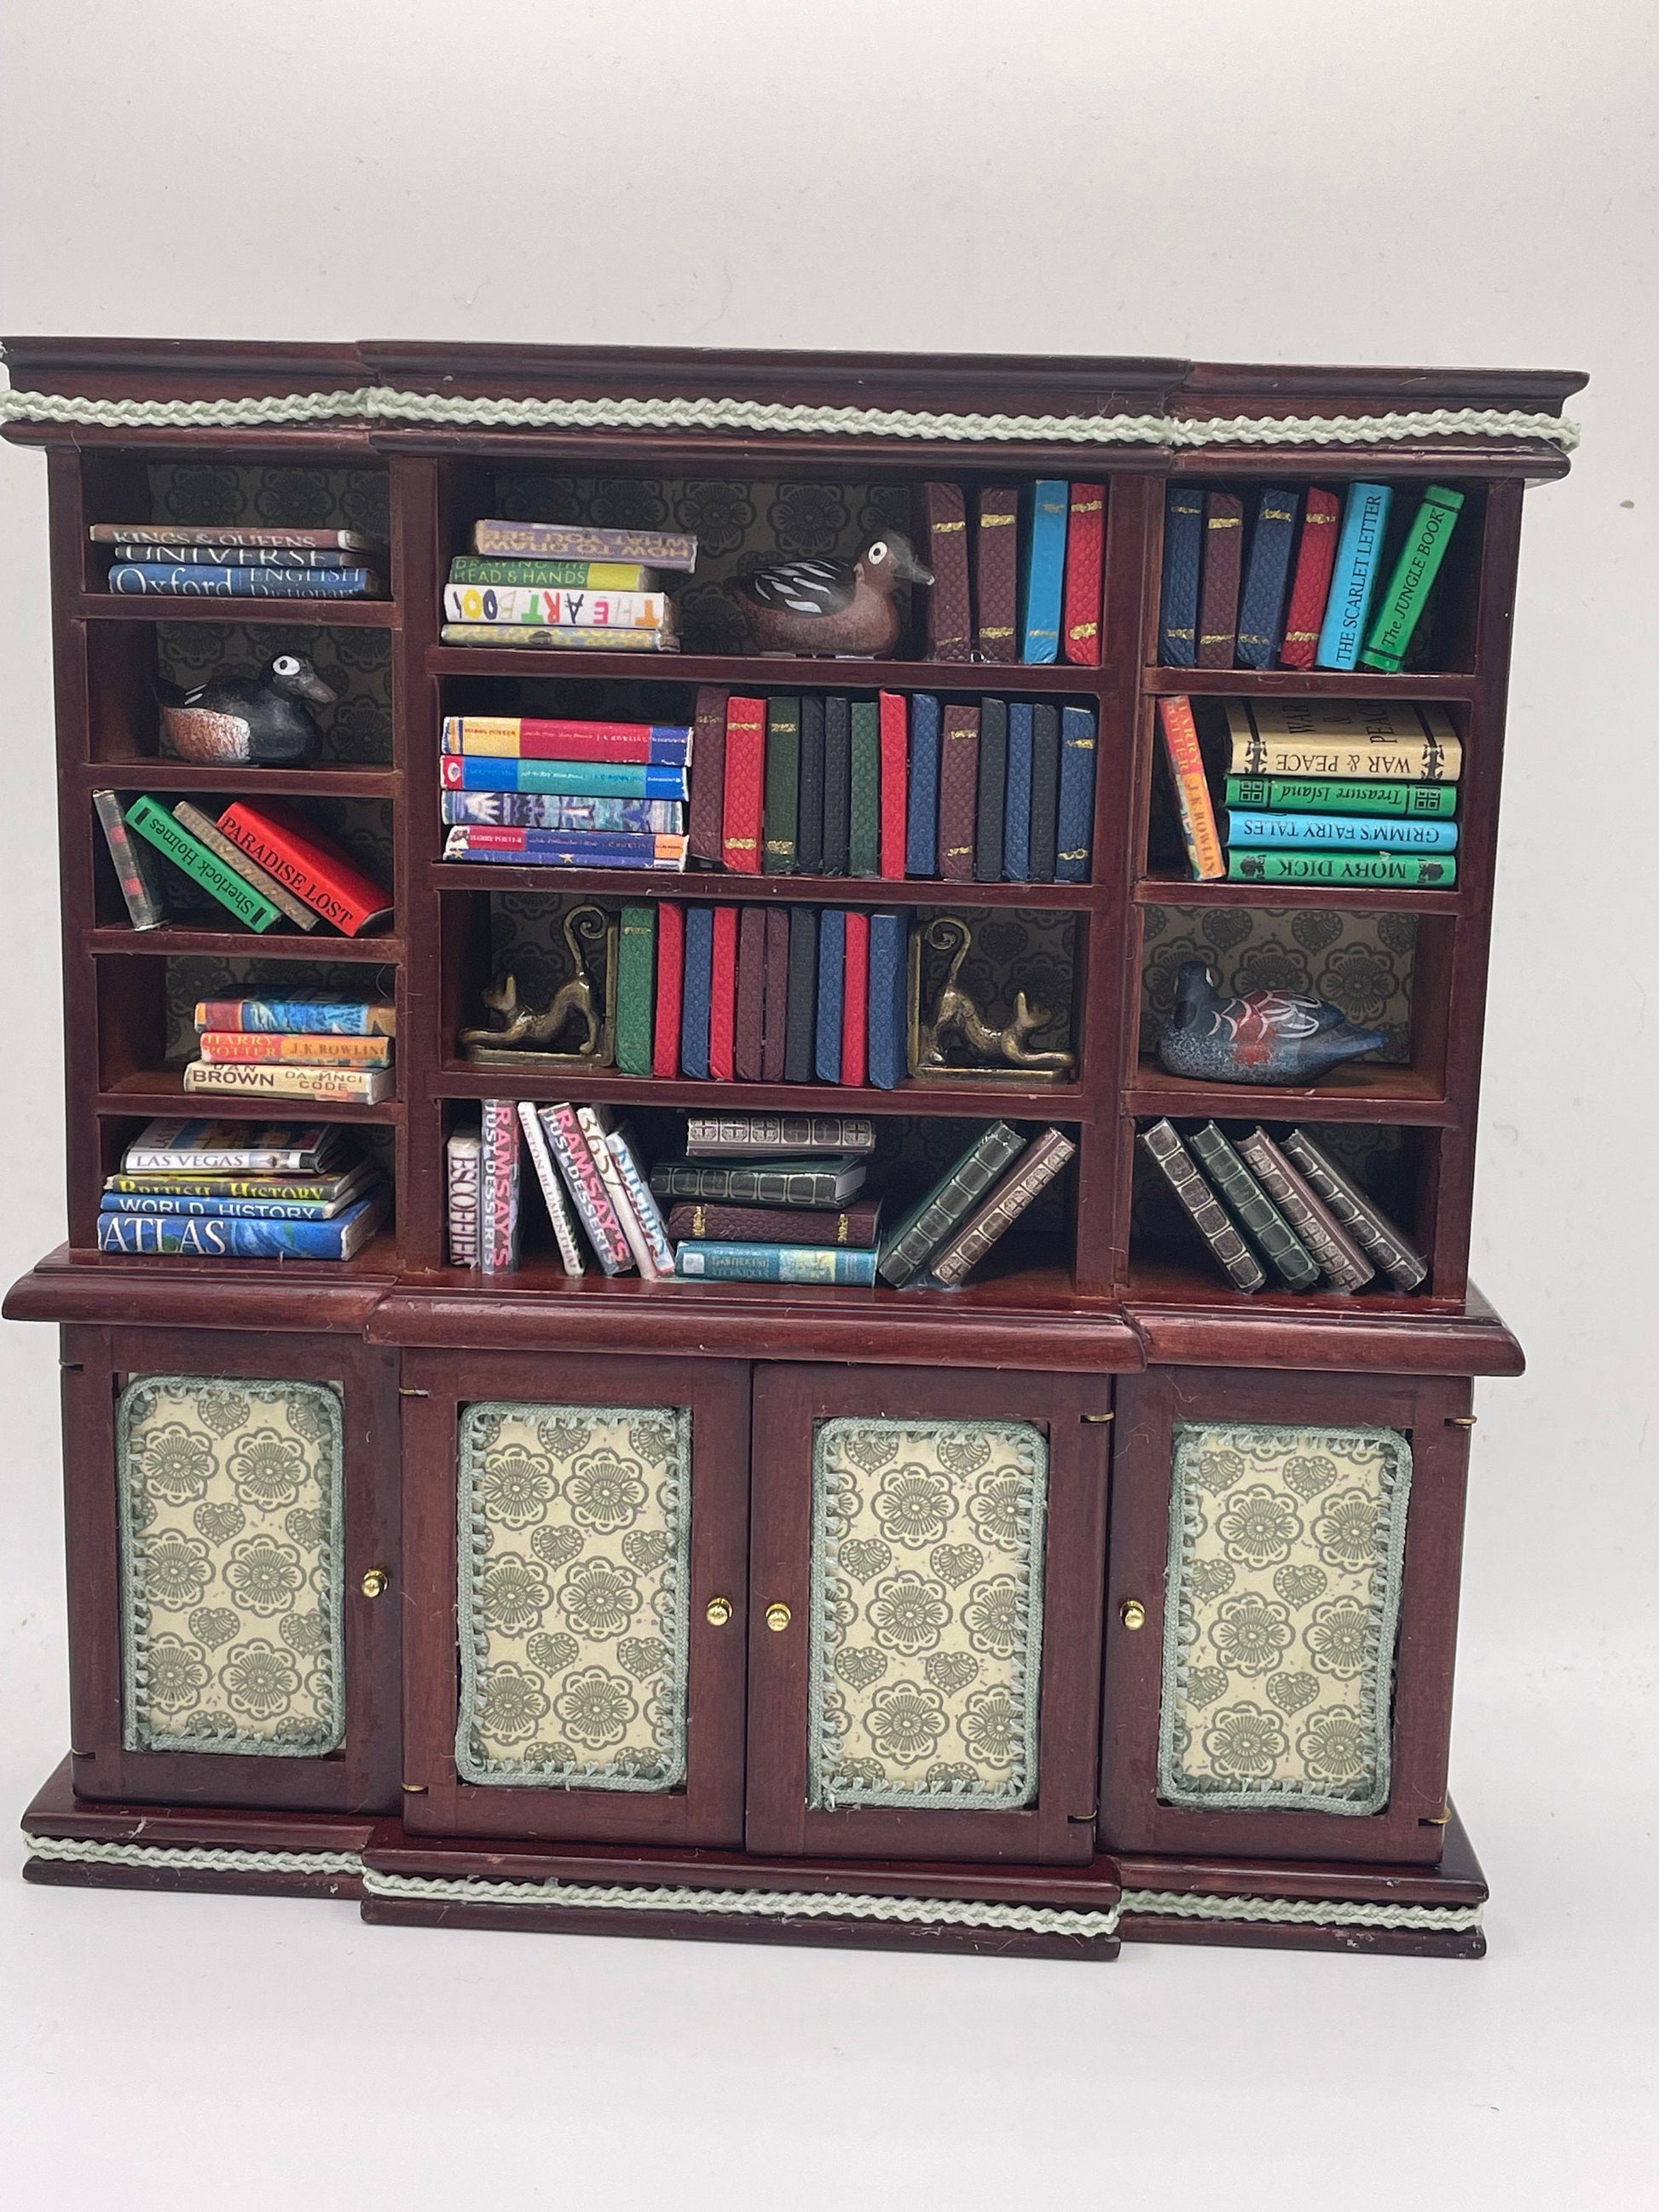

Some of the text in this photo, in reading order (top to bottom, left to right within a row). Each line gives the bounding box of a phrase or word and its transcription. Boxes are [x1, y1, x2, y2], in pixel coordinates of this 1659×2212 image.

[113, 531, 317, 547] KINGS & QUEENS
[127, 546, 327, 566] UNIVERSE
[116, 569, 233, 596] Oxford
[251, 568, 359, 581] ENGLISH
[454, 570, 585, 584] HEAD & HANDS
[1336, 495, 1382, 662] THE SCARLET LETTER
[1381, 508, 1445, 647] The JUNGLE BOOK
[521, 590, 584, 624] ART
[593, 599, 660, 627] THE
[1282, 705, 1316, 734] WAR
[1275, 754, 1411, 773] WAR & PEACE
[1280, 785, 1402, 805] Treasure Island
[1244, 821, 1440, 844] GRIMM'S FAIRY TALES
[150, 817, 255, 915] Sherlock Holmes
[221, 816, 354, 926] PARADISE LOST
[1279, 860, 1407, 880] MOBY DICK
[193, 1070, 275, 1087] BROWN
[285, 1071, 307, 1080] DA
[299, 1081, 349, 1092] CODE
[136, 1155, 244, 1167] LAS VEGAS
[483, 1104, 497, 1267] JUST DESSERTS
[493, 1106, 512, 1267] RAMSAY'S
[544, 1114, 616, 1268] JUST DESSERTS
[556, 1107, 631, 1263] RAMSAY'S
[119, 1198, 317, 1220] WORLD HISTORY
[450, 1157, 478, 1266] ESCOFFIER
[102, 1216, 227, 1256] ATLAS
